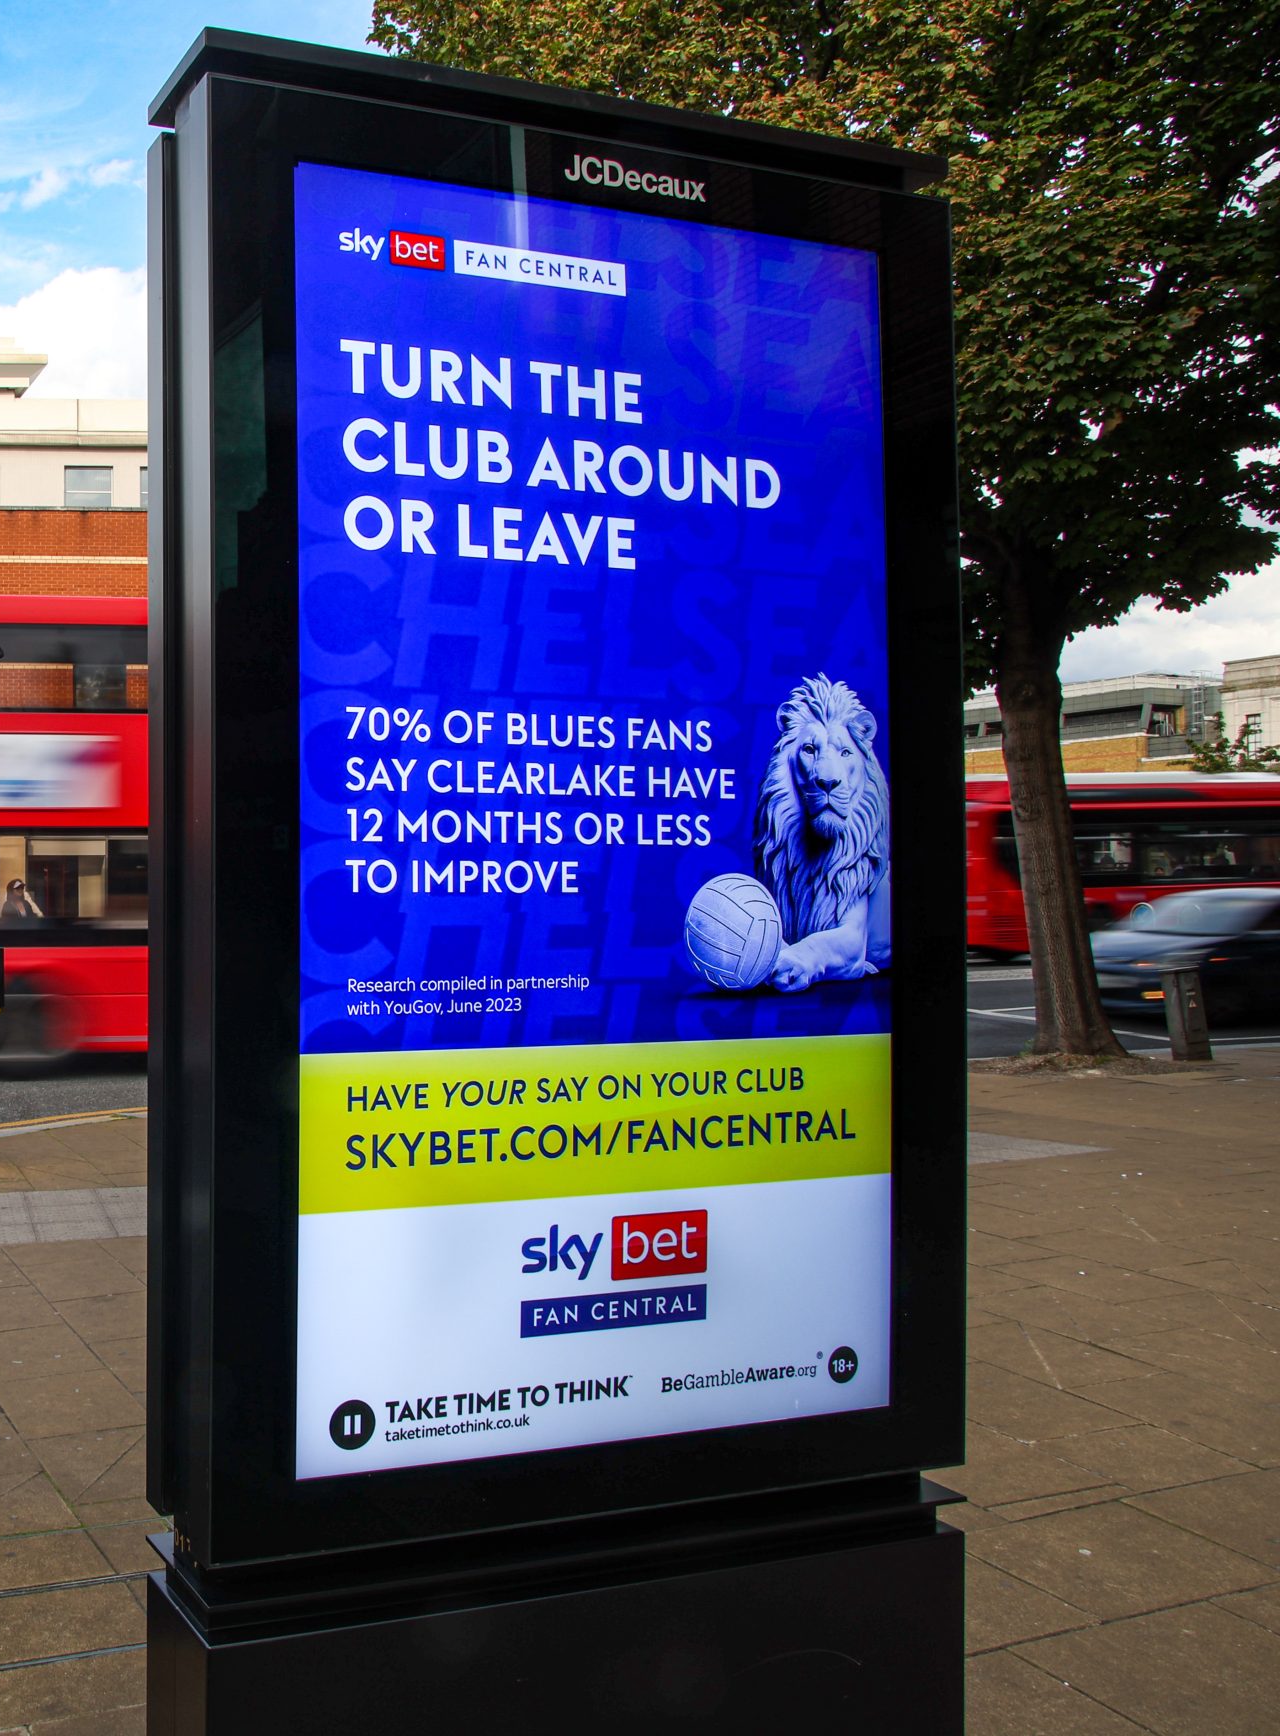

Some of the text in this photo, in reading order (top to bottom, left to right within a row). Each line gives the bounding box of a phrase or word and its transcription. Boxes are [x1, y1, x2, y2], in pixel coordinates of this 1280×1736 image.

[565, 155, 705, 202] JCDecaux
[339, 228, 439, 262] sky bet
[465, 250, 618, 287] FAN CENTRAL
[340, 339, 642, 424] TURN THE
[343, 418, 780, 508] CLUB AROUND
[344, 496, 635, 569] OR LEAVE
[346, 707, 712, 752] 70% OF BLUES FANS
[346, 757, 735, 799] SAY CLEARLAKE HAVE
[347, 809, 711, 846] 12 MONTHS OR LESS
[346, 859, 578, 893] TO IMPROVE
[348, 974, 590, 995] Research compiled in partnership
[347, 998, 521, 1016] with YouGov, June 2023
[348, 1067, 804, 1112] HAVE YOUR SAY ON YOUR CLUB
[346, 1108, 856, 1170] SKYBET.COM/FANCENTRAL
[522, 1221, 697, 1280] sky bet
[534, 1294, 696, 1326] FAN CENTRAL
[662, 1366, 817, 1393] BeGambleAware.org
[833, 1359, 854, 1373] 18+
[386, 1376, 628, 1423] TAKE TIME TO THINK
[385, 1413, 530, 1442] taketimetothink.co.uk
